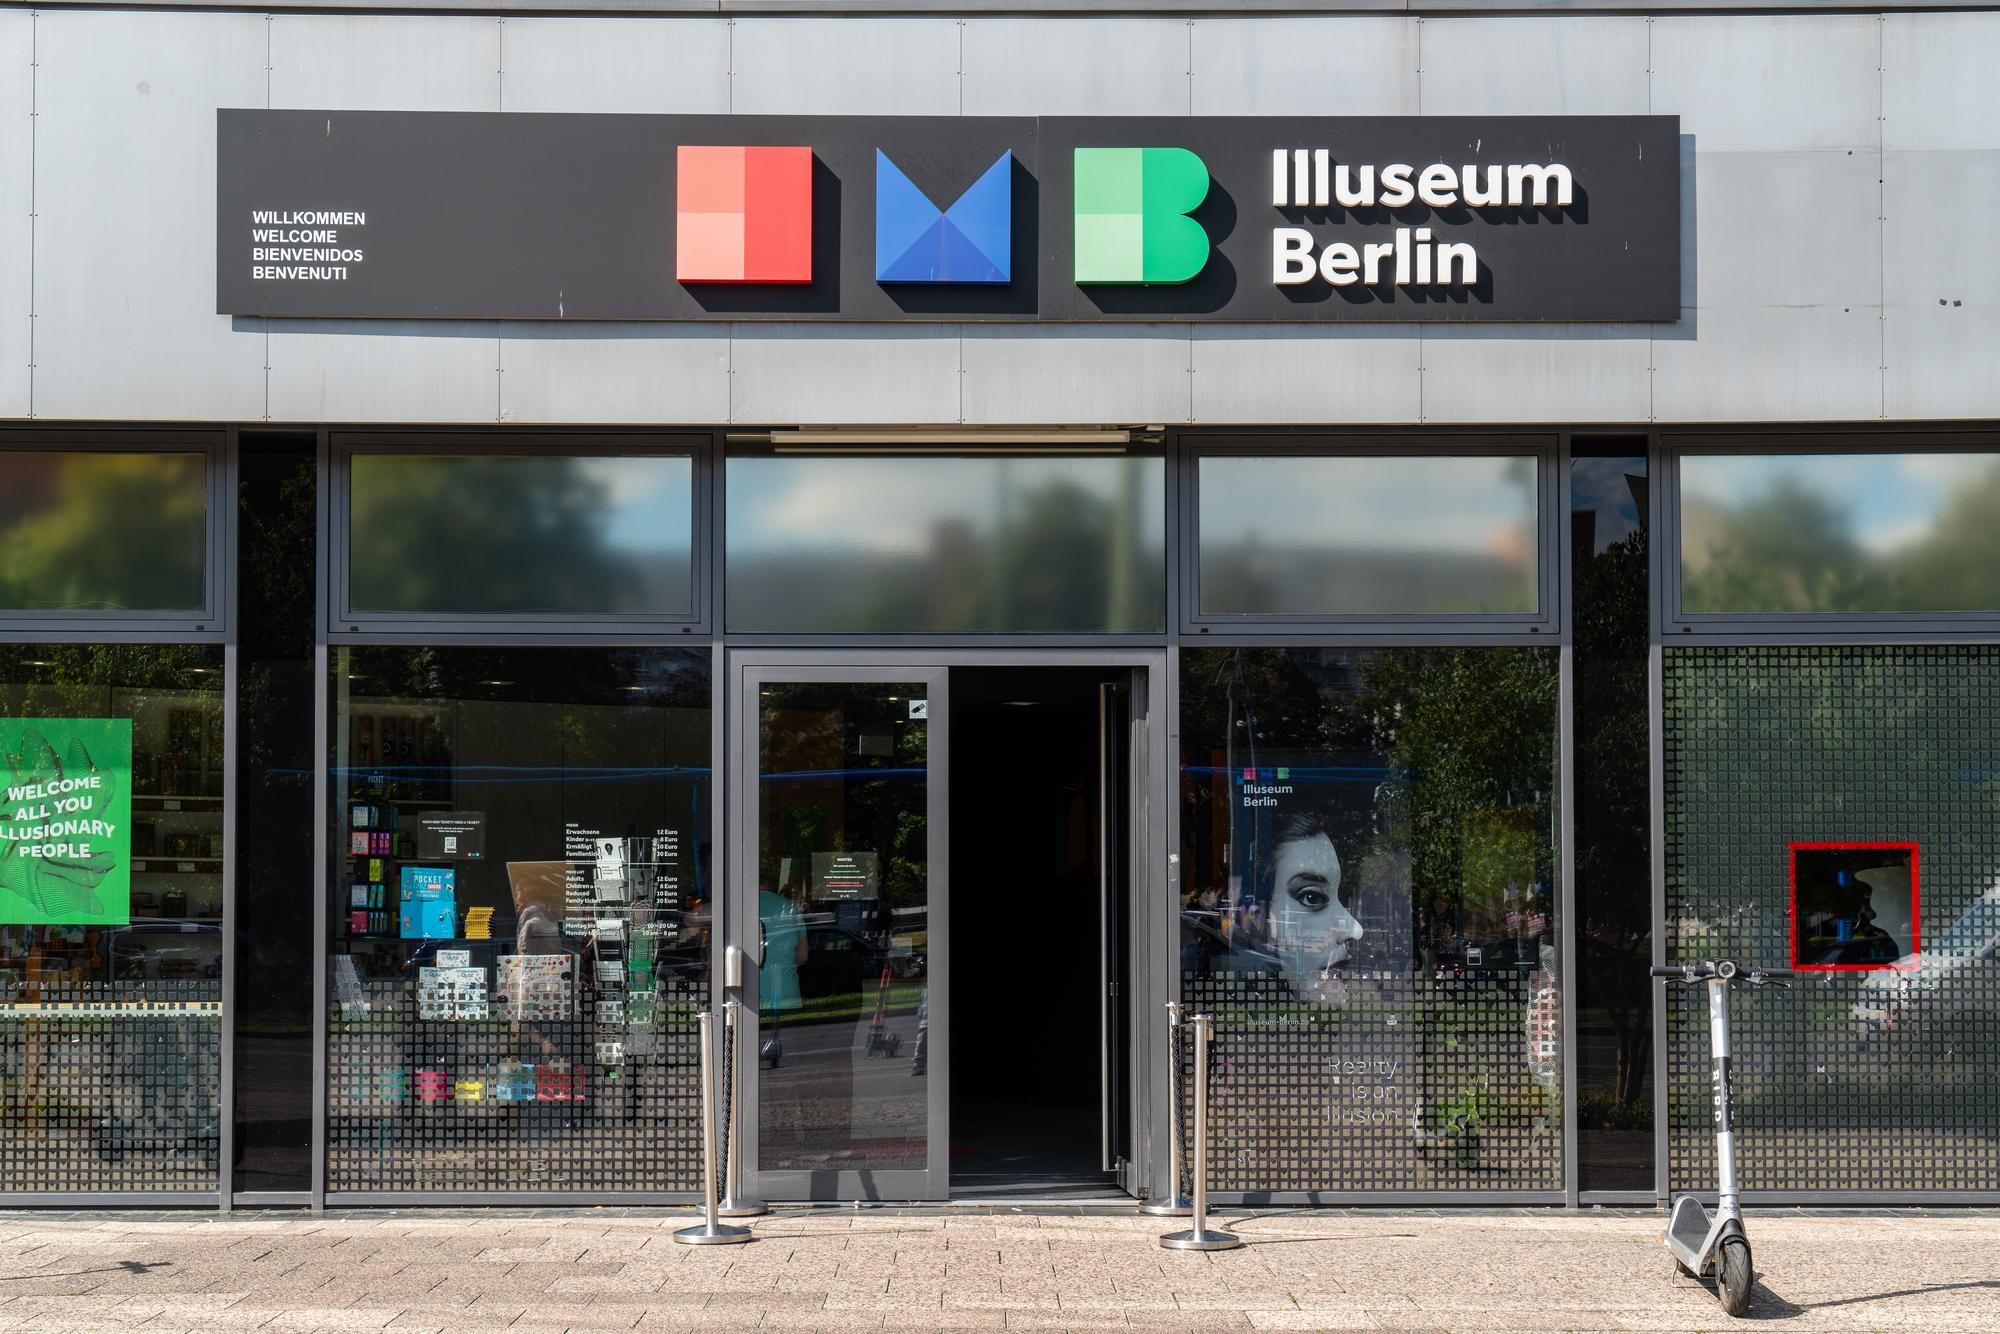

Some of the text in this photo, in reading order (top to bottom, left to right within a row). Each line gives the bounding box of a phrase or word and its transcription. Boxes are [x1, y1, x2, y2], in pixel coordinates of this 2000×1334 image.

[1273, 149, 1572, 207] Illuseum
[252, 210, 366, 225] WILLKOMMEN
[252, 229, 338, 243] WELCOME
[253, 247, 364, 262] BIENVENIDOS
[1273, 228, 1477, 286] Berlin
[253, 266, 347, 280] BENVENUTI
[7, 776, 101, 801] WELCOME
[1243, 784, 1293, 794] Illuseum
[14, 795, 93, 821] ALL YOU
[1243, 796, 1278, 807] Berlin
[0, 819, 116, 840] LLUSIONARY
[19, 843, 91, 858] PEOPLE
[414, 875, 442, 884] POCKET
[1352, 1083, 1398, 1099] is an
